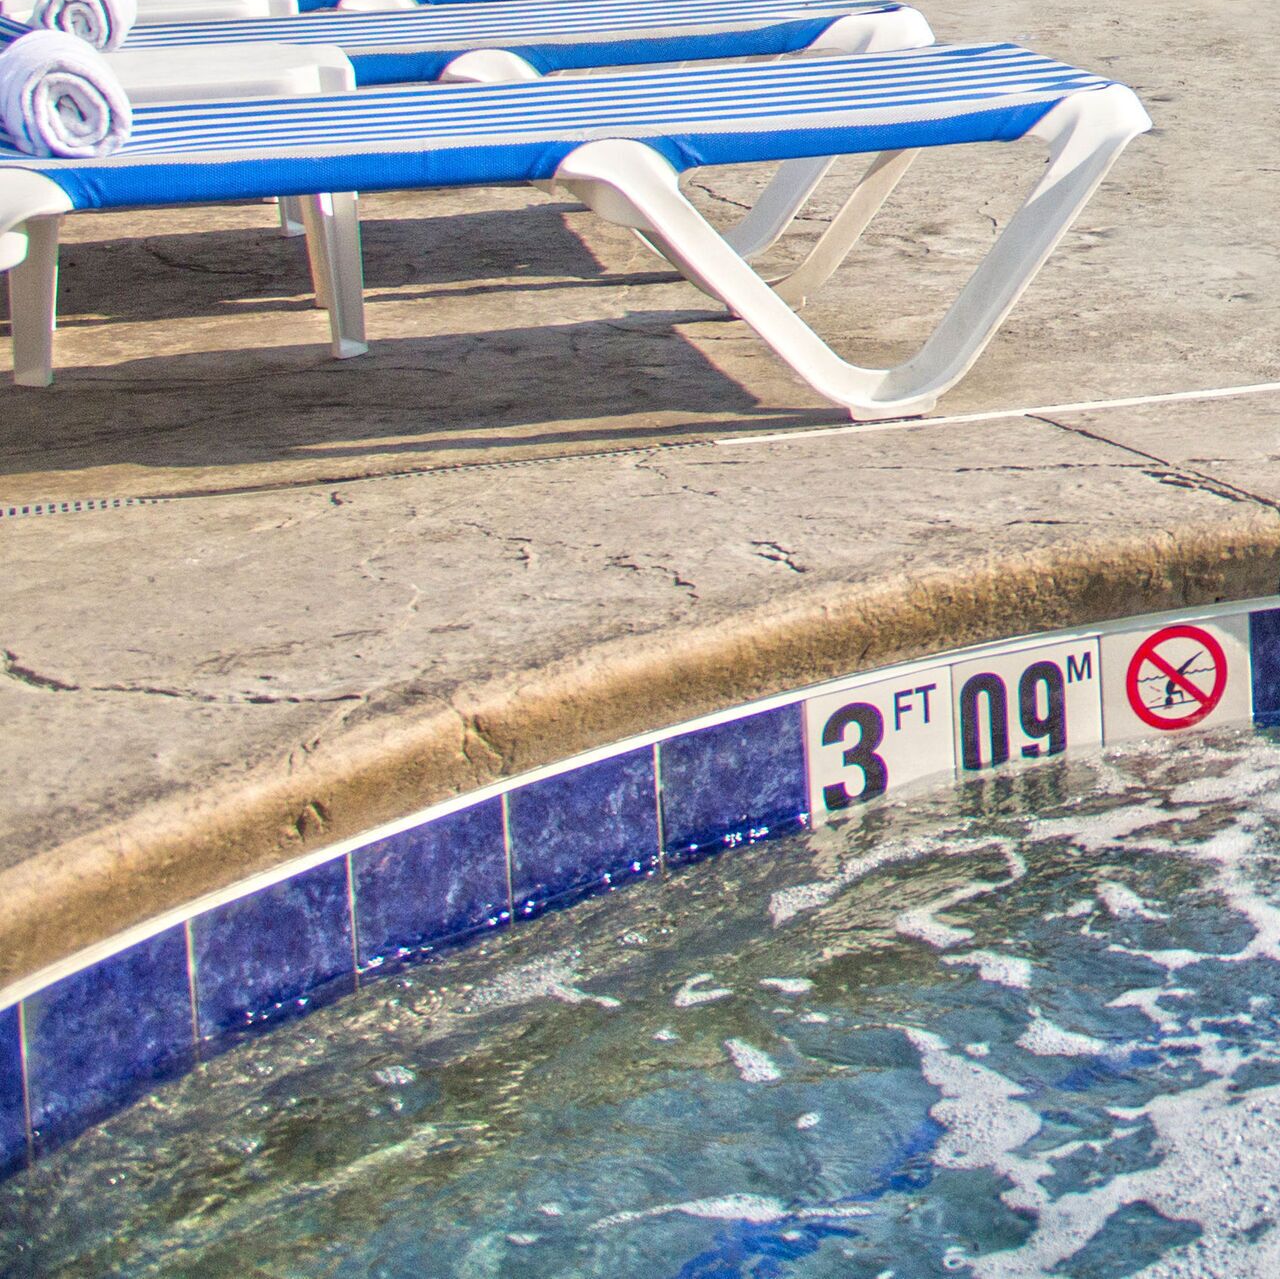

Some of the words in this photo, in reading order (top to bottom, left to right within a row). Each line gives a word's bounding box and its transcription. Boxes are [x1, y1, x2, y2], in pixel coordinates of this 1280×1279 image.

[822, 702, 888, 810] 3
[894, 683, 936, 731] FT
[960, 660, 1067, 771] 09
[1067, 652, 1092, 684] M
